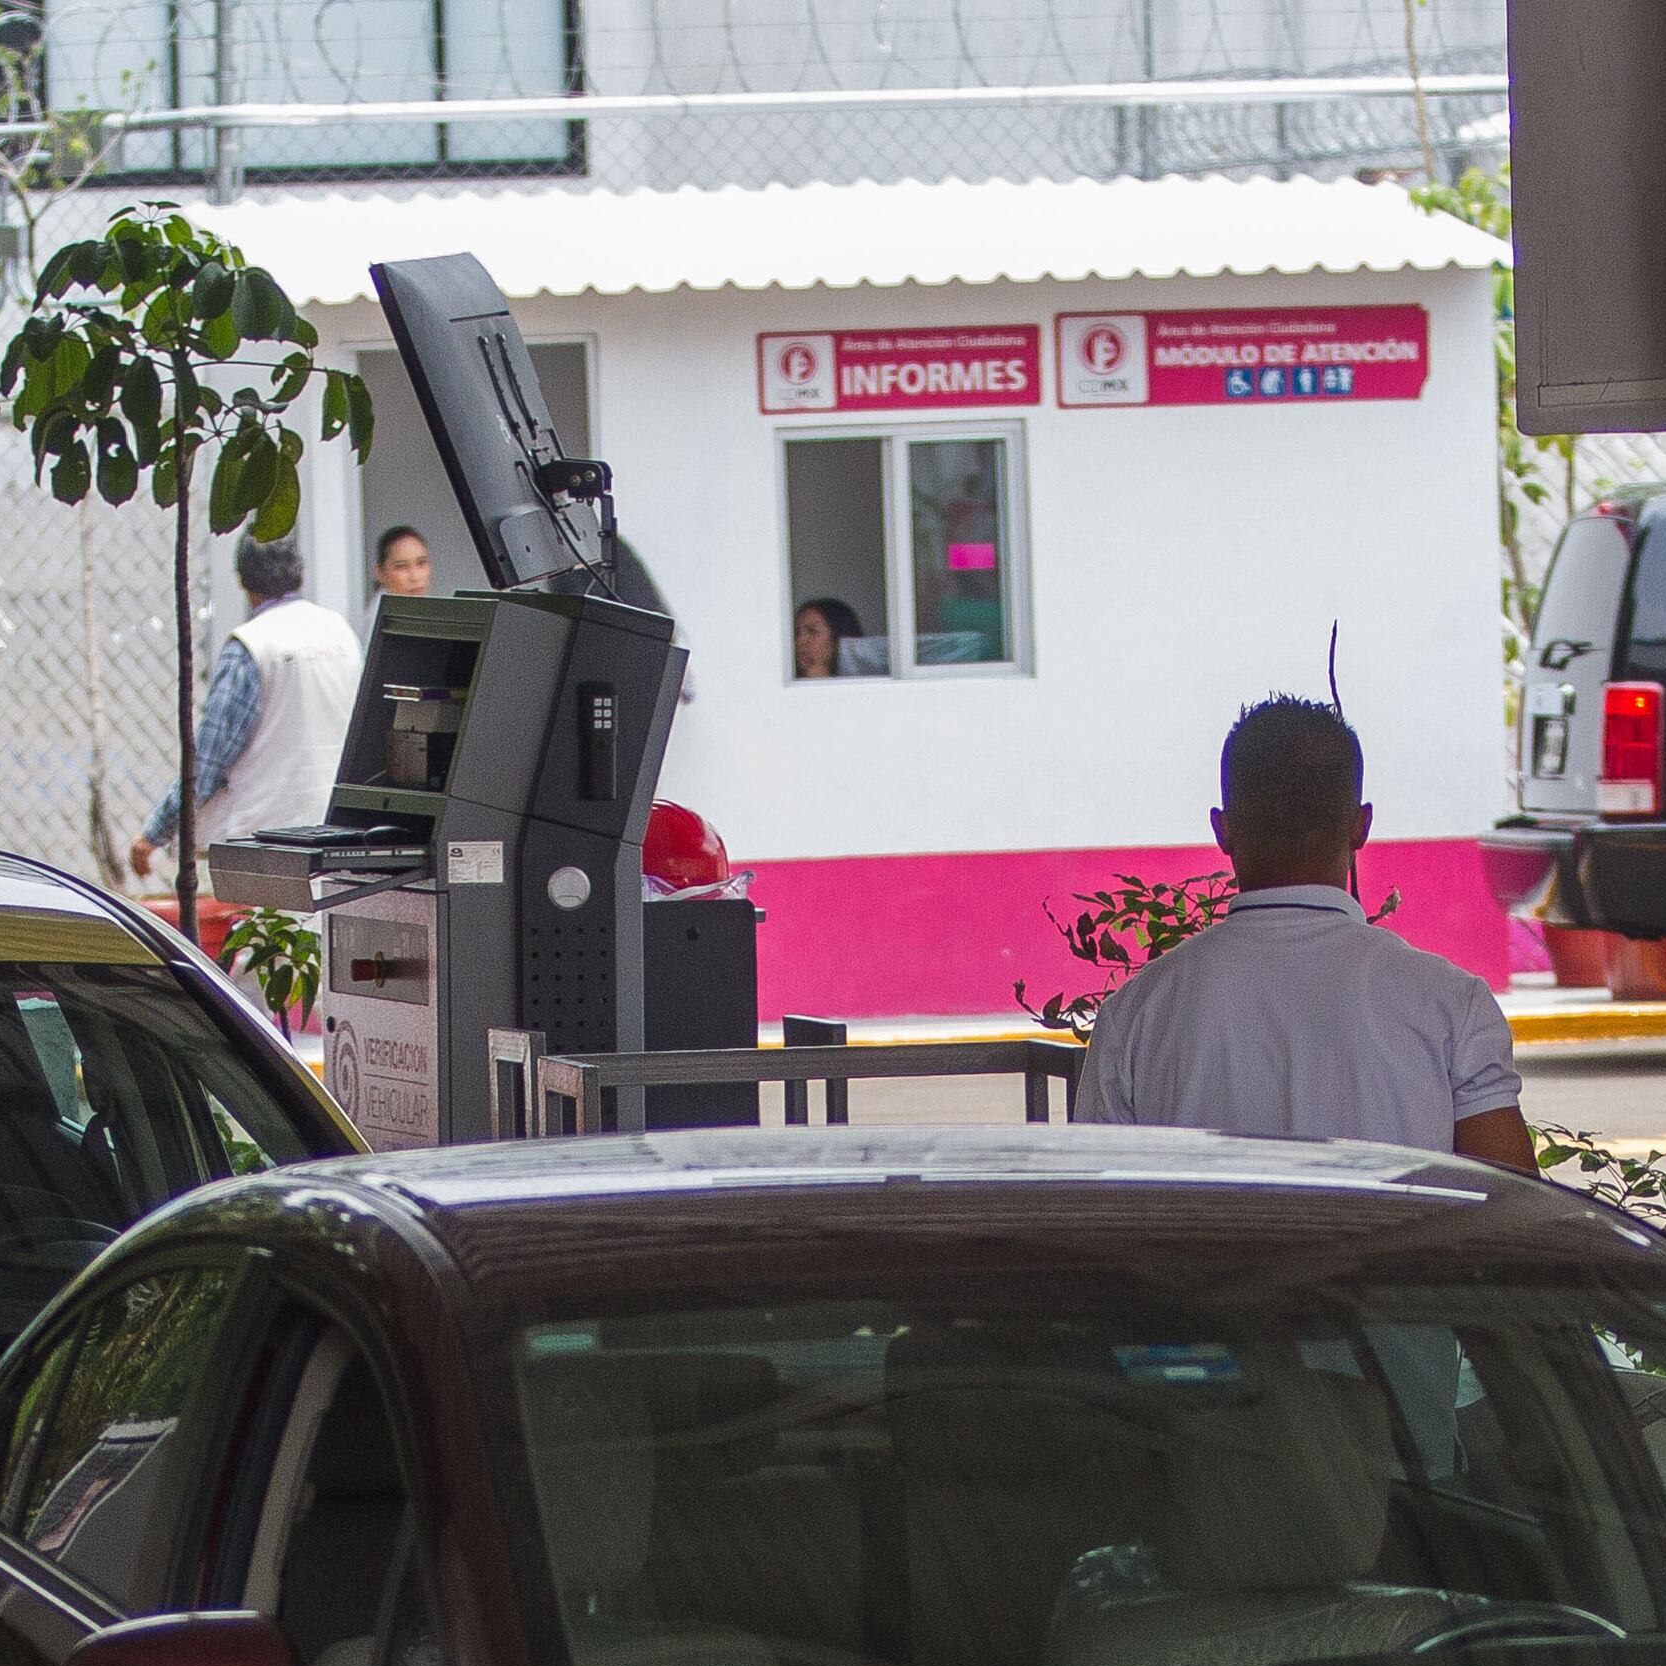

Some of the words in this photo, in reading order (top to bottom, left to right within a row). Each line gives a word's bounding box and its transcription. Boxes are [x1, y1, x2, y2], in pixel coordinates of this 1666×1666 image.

[1155, 343, 1260, 366] MÓDULO
[1264, 344, 1297, 363] DE
[1300, 338, 1420, 363] ATENCIÓN
[841, 359, 1028, 396] INFORMES
[363, 1084, 429, 1127] VEHICULAR
